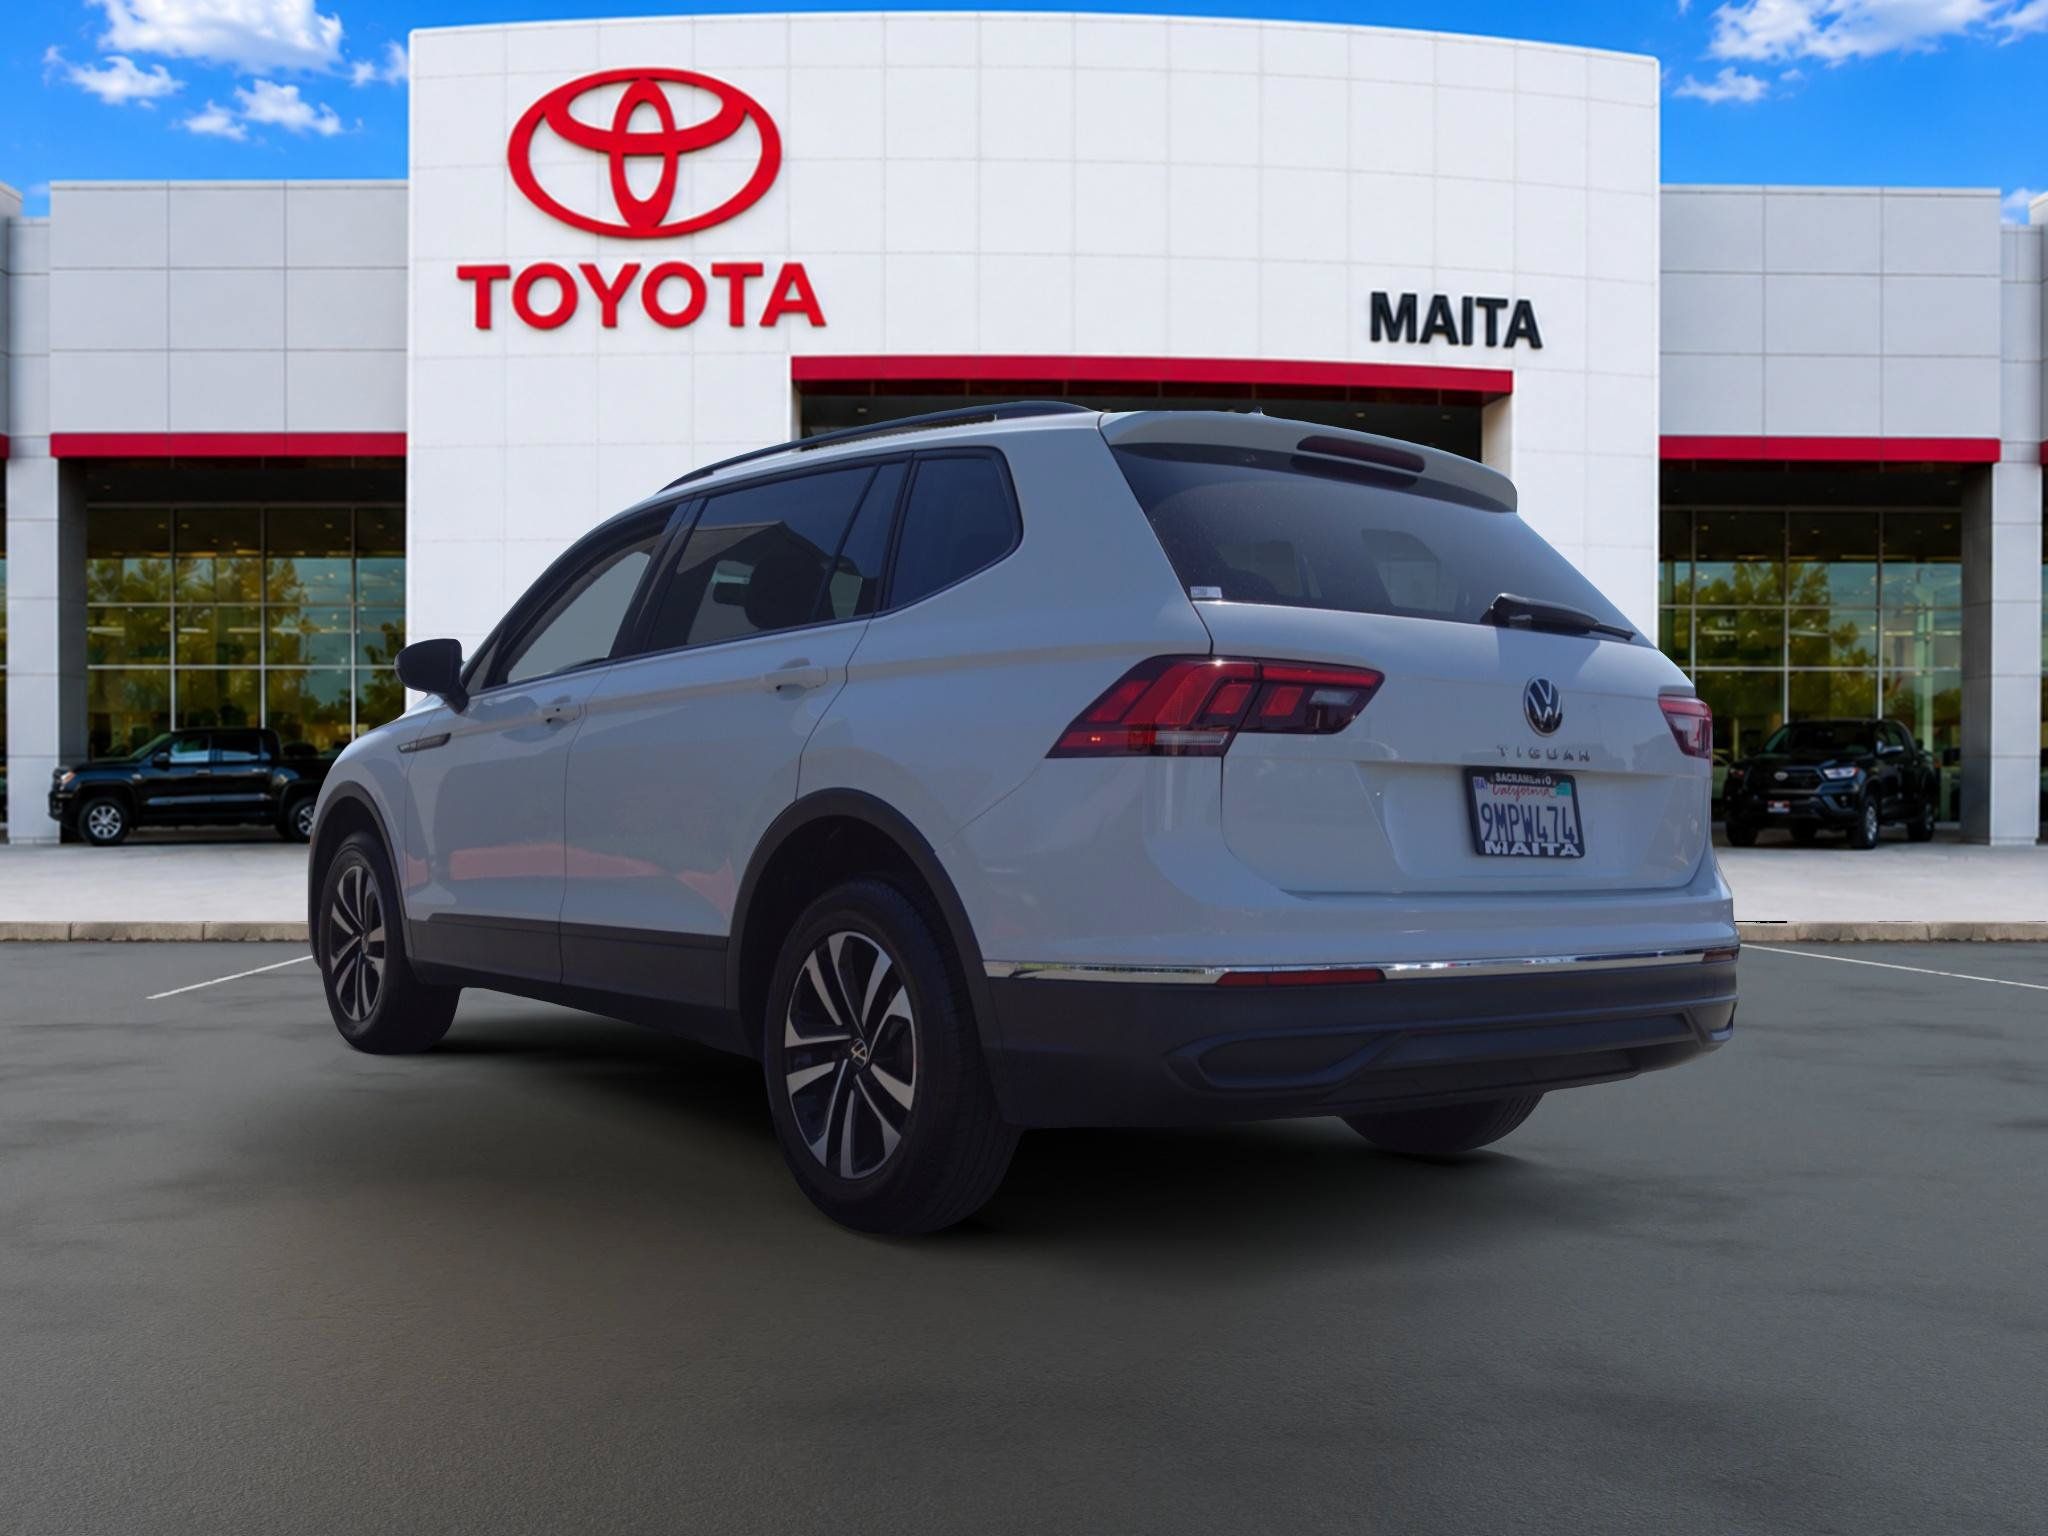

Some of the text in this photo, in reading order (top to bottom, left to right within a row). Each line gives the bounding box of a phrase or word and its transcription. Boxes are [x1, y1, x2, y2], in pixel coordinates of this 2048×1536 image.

[457, 262, 826, 330] TOYOTA
[1370, 292, 1543, 349] MAITA
[1497, 745, 1591, 762] TIGUAN
[1495, 772, 1552, 785] SACRAMENTO
[1480, 802, 1576, 844] 9MPW474
[1484, 840, 1580, 857] MAITA
